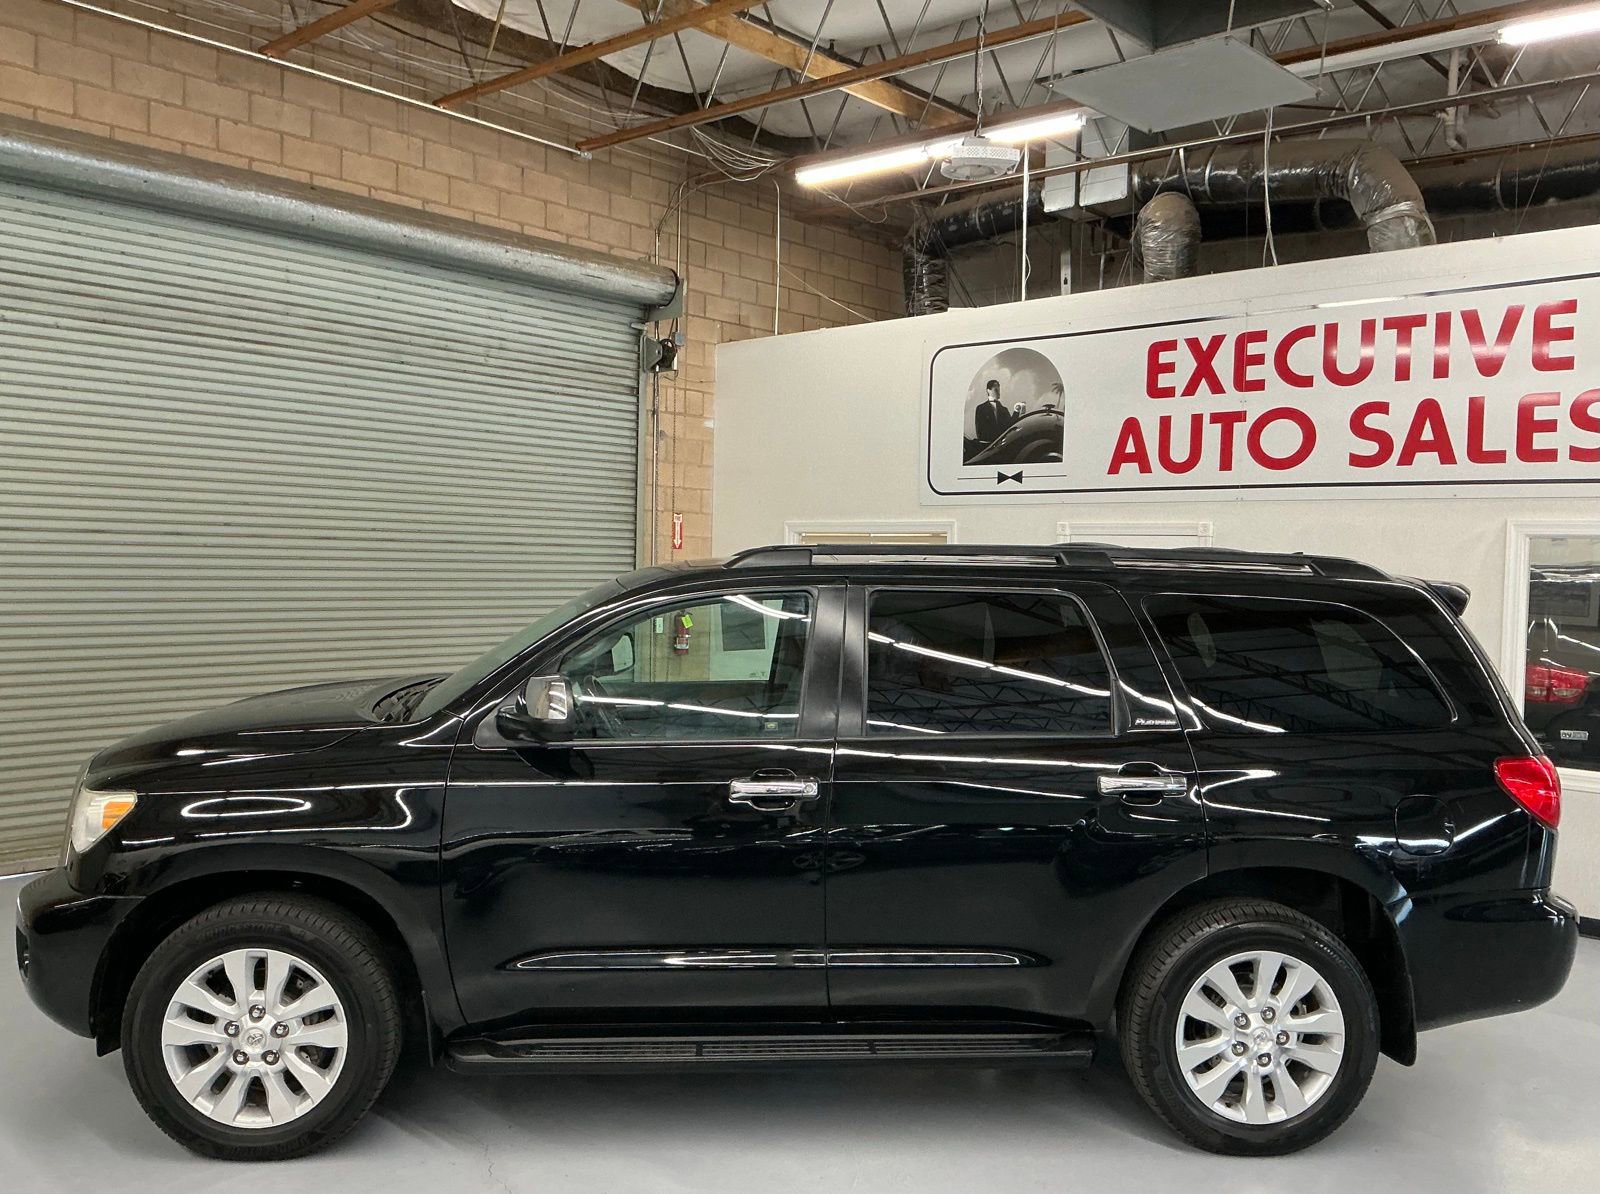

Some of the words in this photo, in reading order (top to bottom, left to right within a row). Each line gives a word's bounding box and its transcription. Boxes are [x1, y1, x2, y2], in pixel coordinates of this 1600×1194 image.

[1146, 299, 1577, 399] EXECUTIVE
[1107, 407, 1317, 475] AUTO
[1349, 389, 1600, 468] SALES
